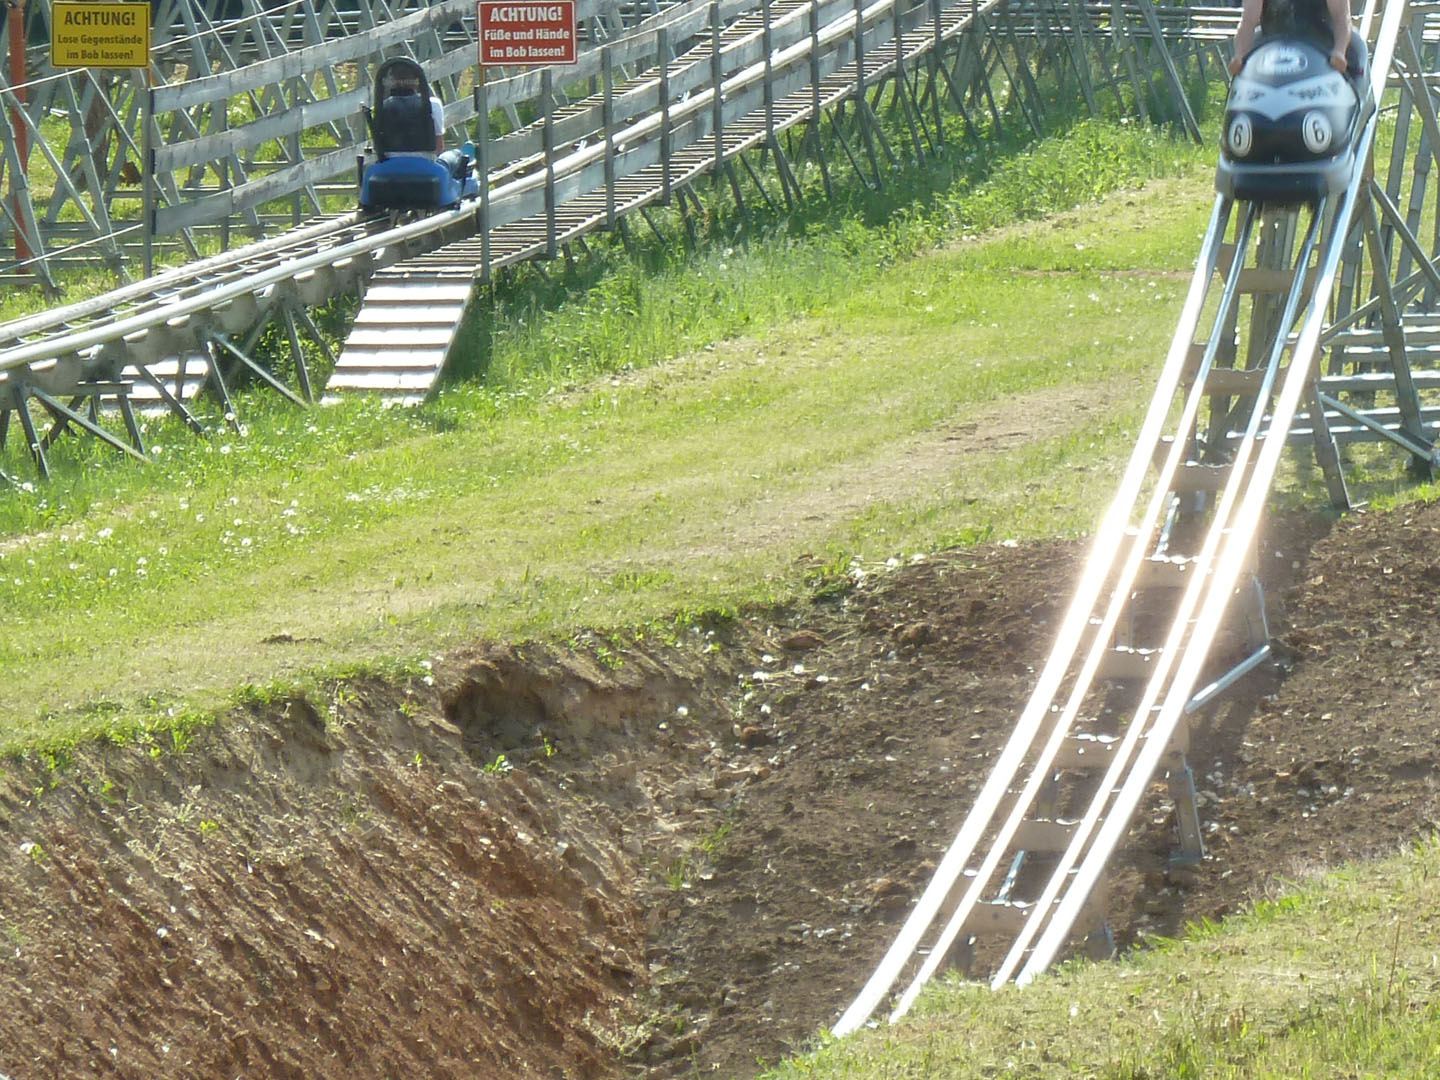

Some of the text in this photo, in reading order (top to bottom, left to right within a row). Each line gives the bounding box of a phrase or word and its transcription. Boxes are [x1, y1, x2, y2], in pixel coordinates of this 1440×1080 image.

[64, 11, 136, 26] ACHTUNG!
[490, 6, 562, 22] ACHTUNG!
[58, 34, 142, 46] Lose Gegenstände
[484, 28, 570, 41] Füße und Hände
[67, 50, 133, 59] im Bob lassen!
[490, 45, 565, 58] im Bob lassen!
[1233, 124, 1243, 147] 6
[1312, 120, 1325, 144] 6
